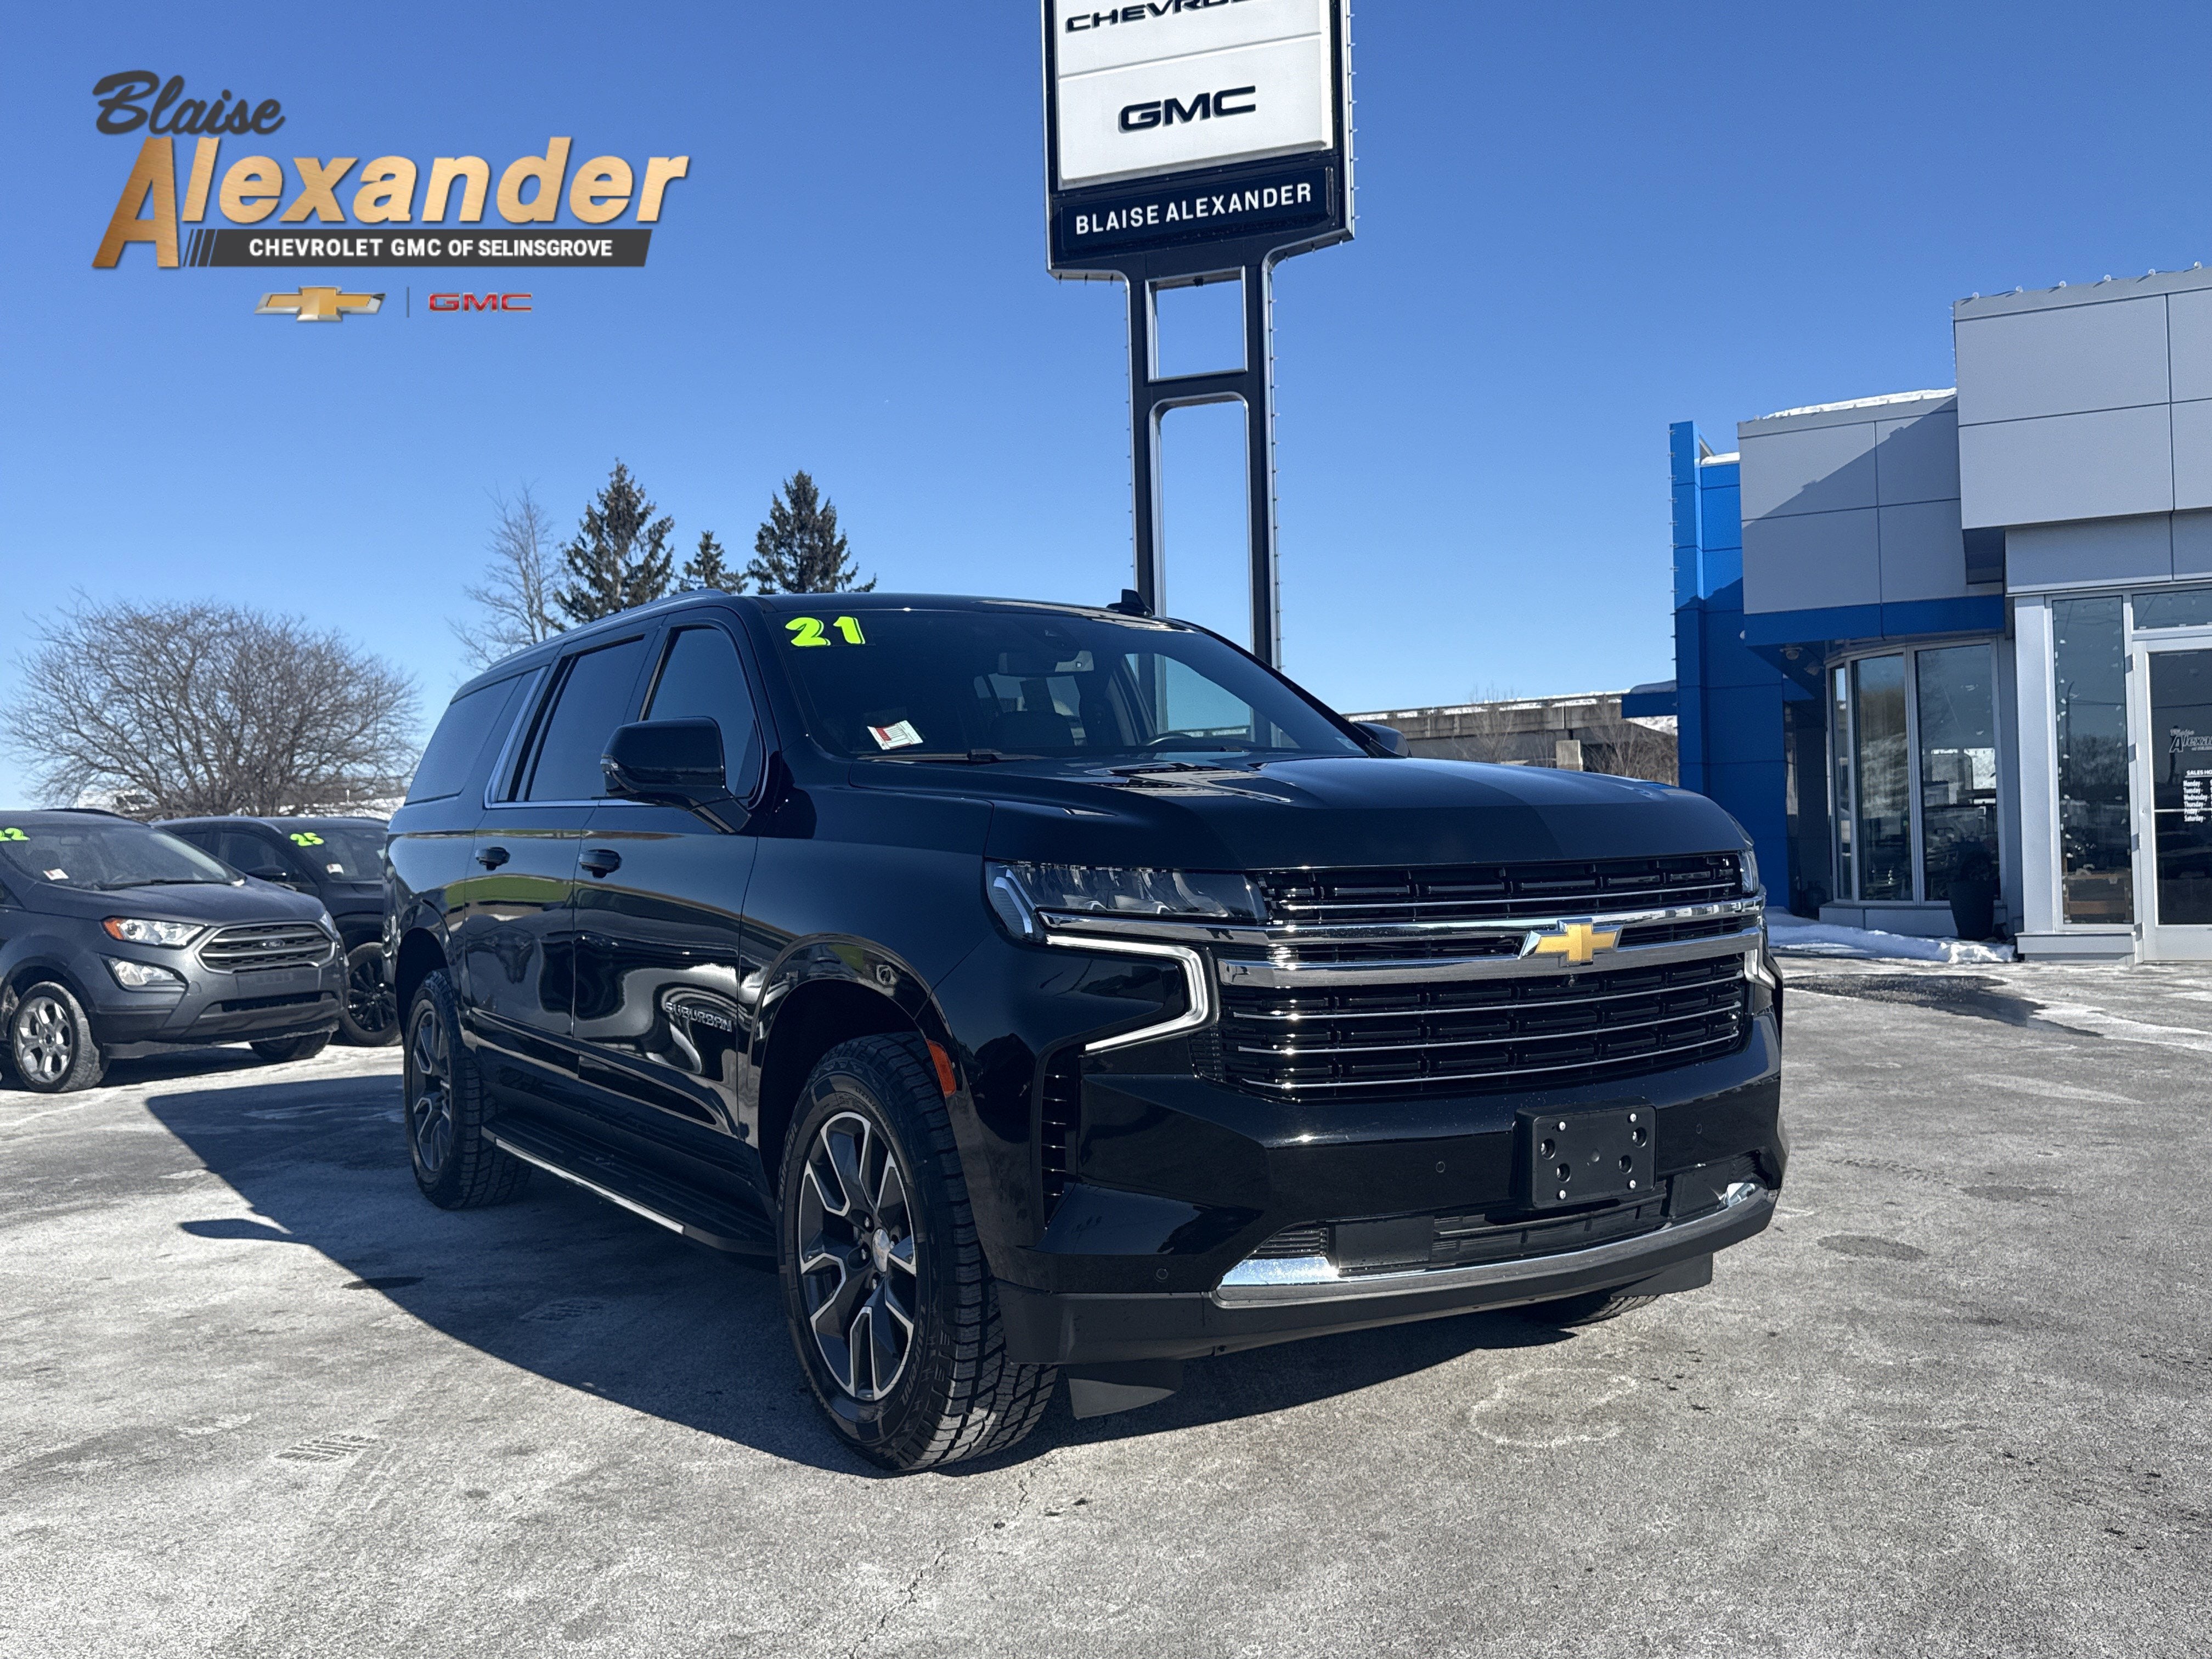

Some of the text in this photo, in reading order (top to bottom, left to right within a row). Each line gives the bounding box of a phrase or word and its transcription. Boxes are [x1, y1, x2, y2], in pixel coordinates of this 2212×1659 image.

[1066, 0, 1255, 30] CHEVR
[1120, 86, 1256, 131] GMC
[1076, 183, 1312, 235] BLAISE ALEXANDER
[785, 616, 865, 647] 21
[290, 832, 324, 847] 25
[665, 1002, 732, 1032] SUBURBAN
